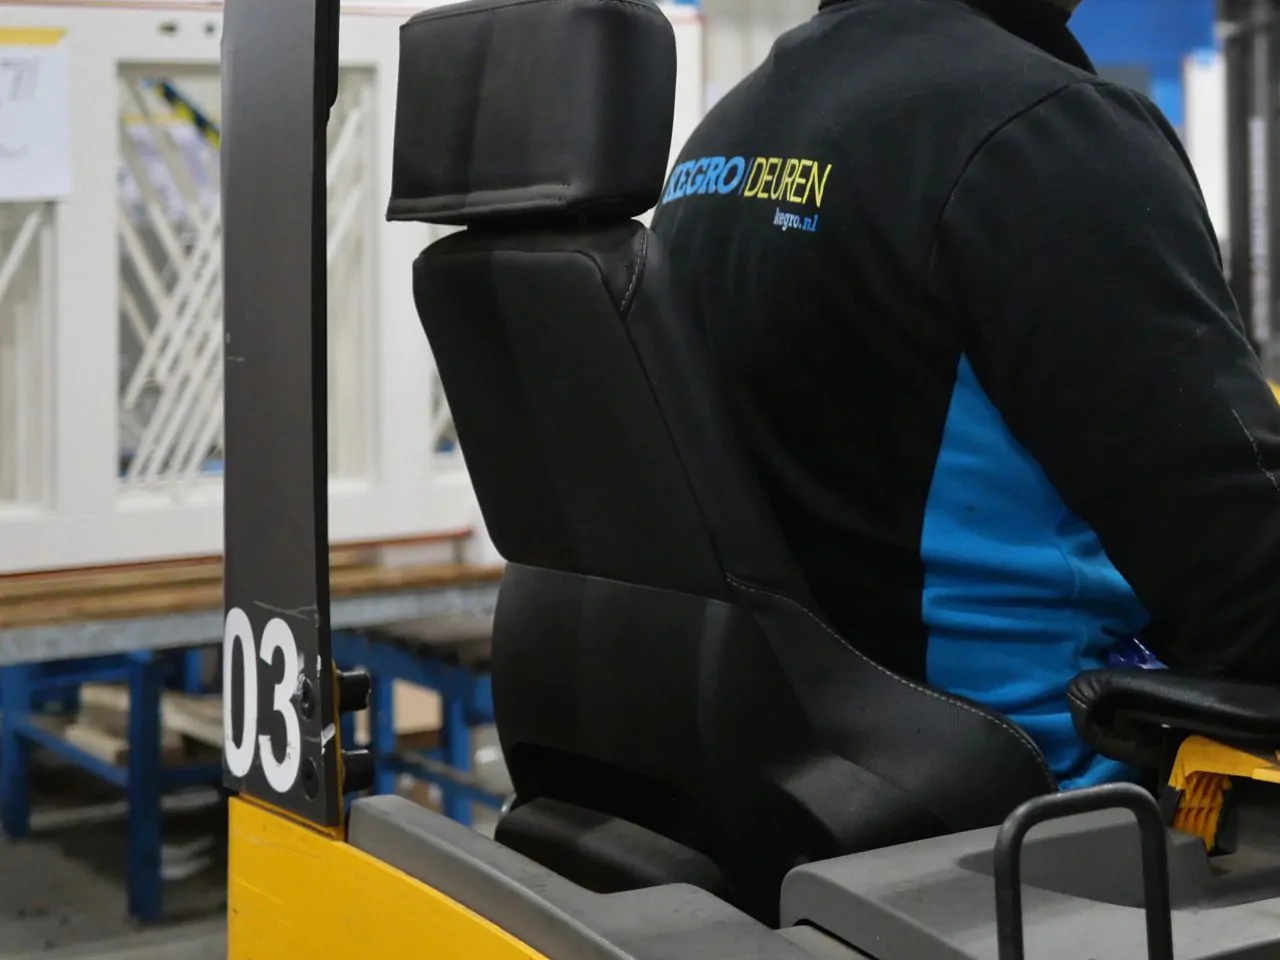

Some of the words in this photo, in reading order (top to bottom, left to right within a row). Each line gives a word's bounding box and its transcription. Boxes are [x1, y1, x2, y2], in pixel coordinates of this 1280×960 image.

[744, 157, 832, 208] DEUREN
[773, 206, 819, 231] kegro.nl
[223, 606, 301, 793] 03
